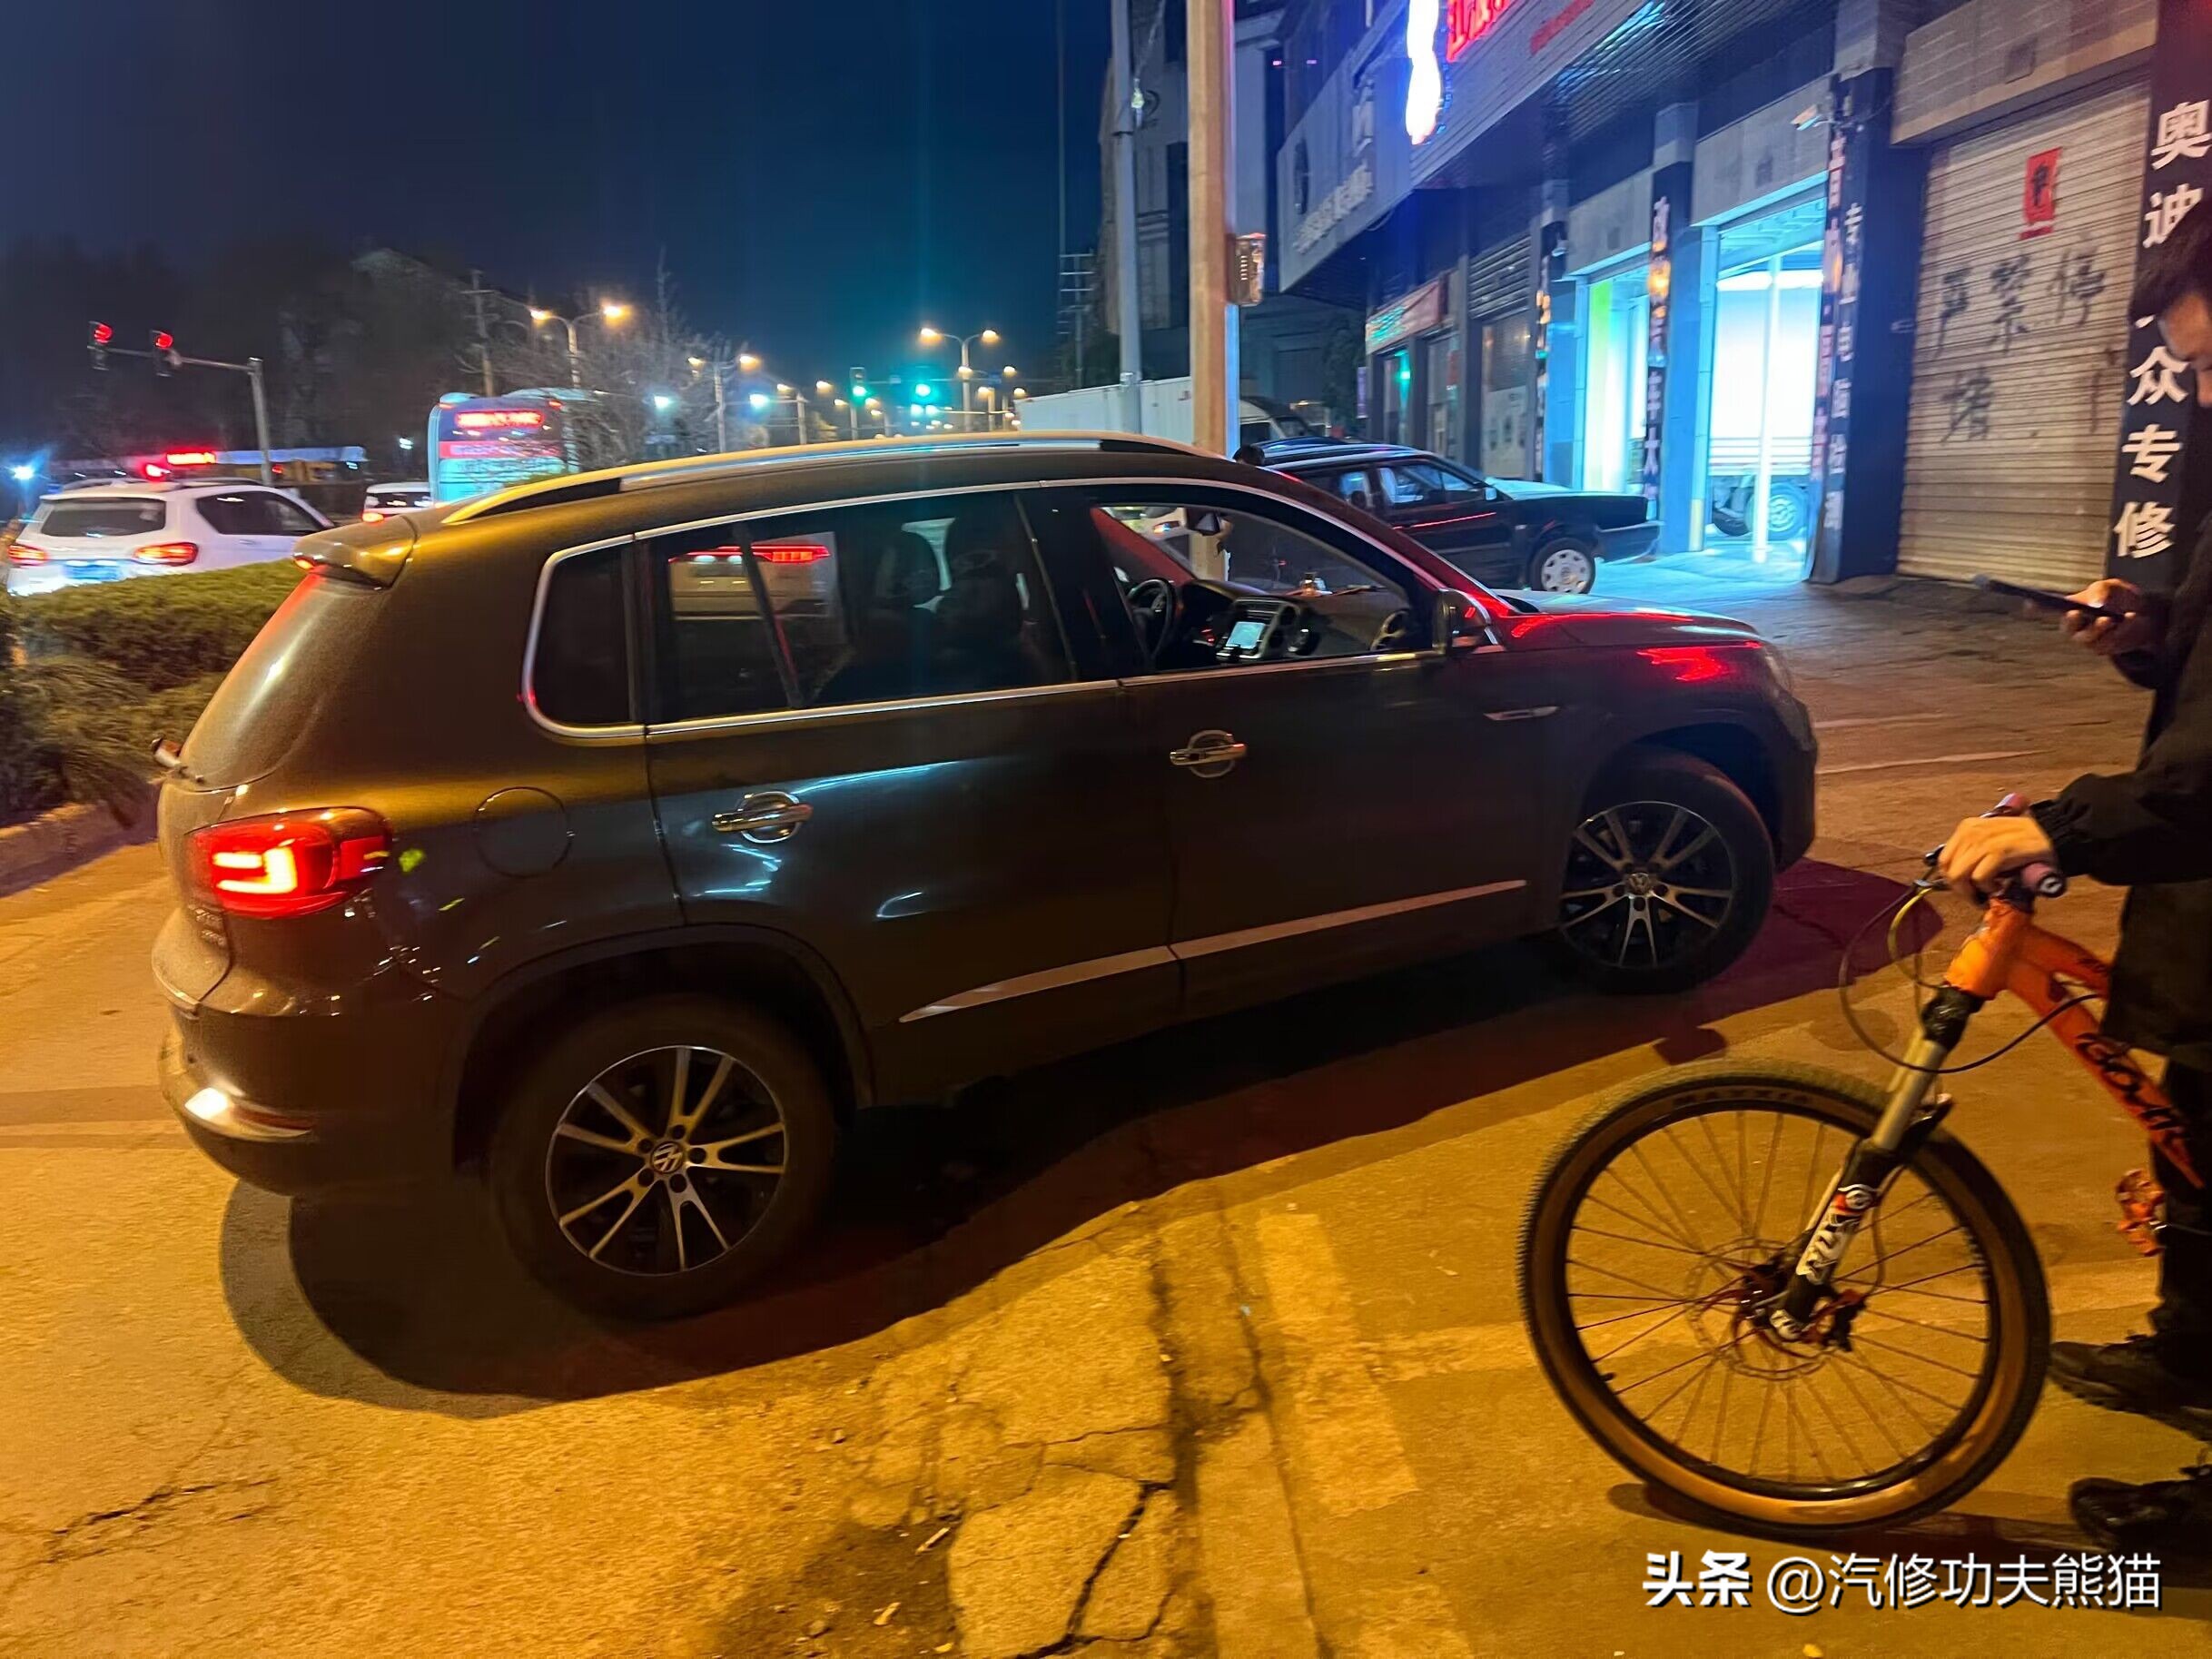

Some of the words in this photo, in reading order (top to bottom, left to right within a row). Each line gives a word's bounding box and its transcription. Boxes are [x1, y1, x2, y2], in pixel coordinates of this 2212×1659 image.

[2112, 98, 2212, 558] 奥迪众专修
